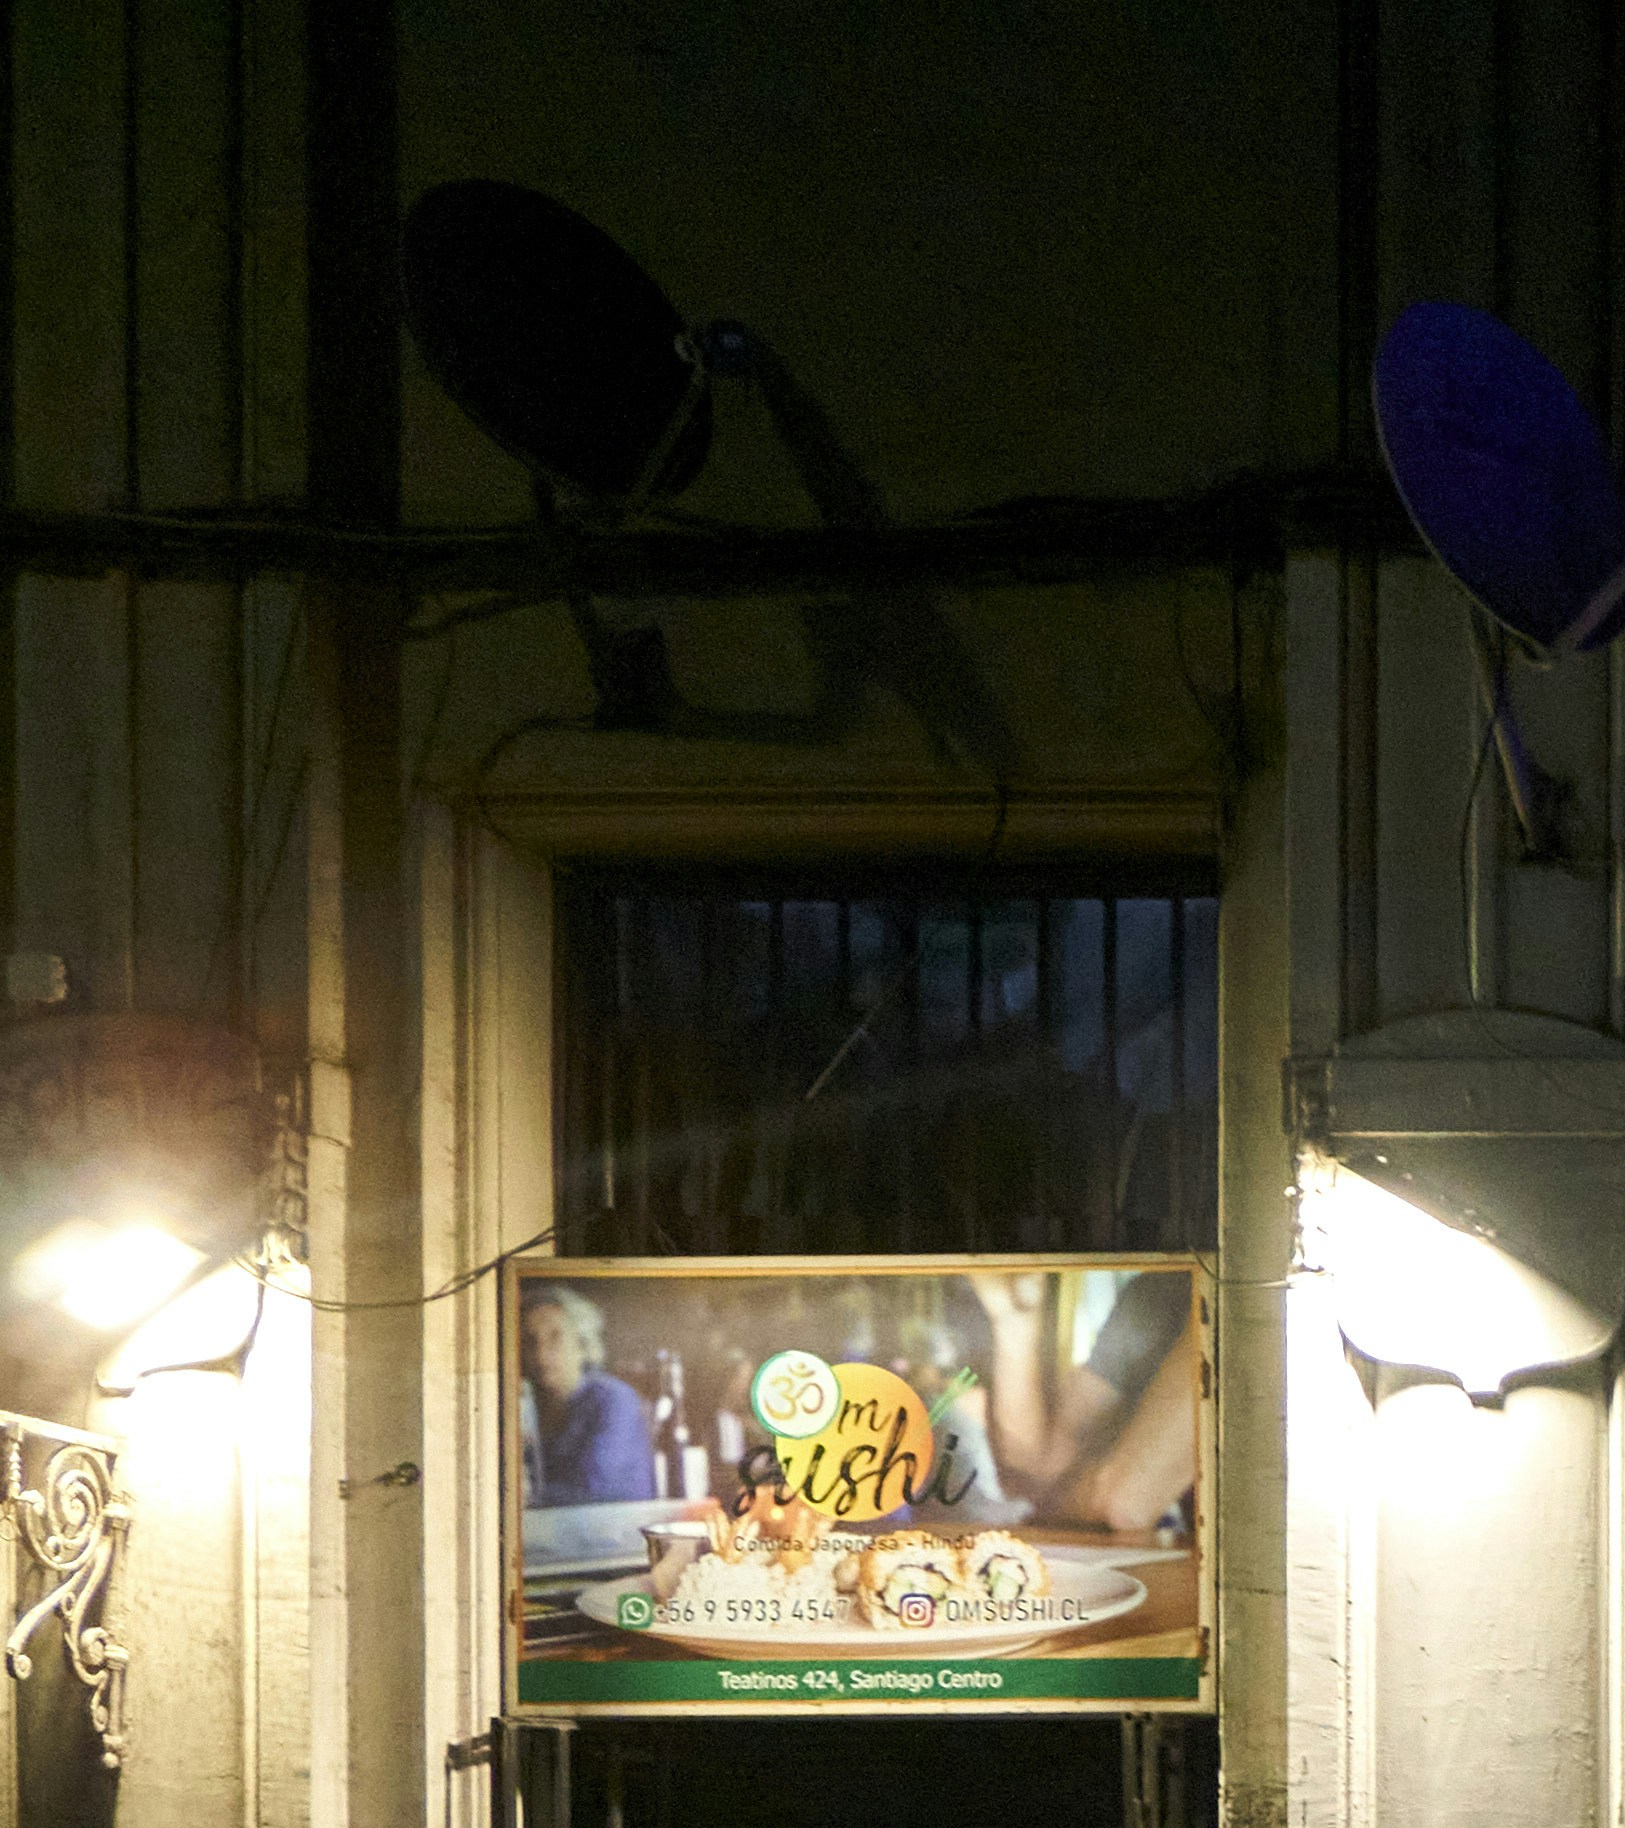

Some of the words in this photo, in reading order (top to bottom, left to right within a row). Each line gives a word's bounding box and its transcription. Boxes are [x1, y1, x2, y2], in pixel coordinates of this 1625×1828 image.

[731, 1406, 978, 1517] sushi
[733, 1536, 802, 1551] Comida
[809, 1536, 899, 1554] Japonesa
[704, 1600, 716, 1622] 9
[726, 1600, 781, 1622] 5933
[791, 1600, 850, 1622] 4547
[719, 1671, 797, 1690] Teatinos
[801, 1670, 844, 1692] 424,
[849, 1670, 934, 1692] Santiago
[937, 1670, 1003, 1689] Centro
